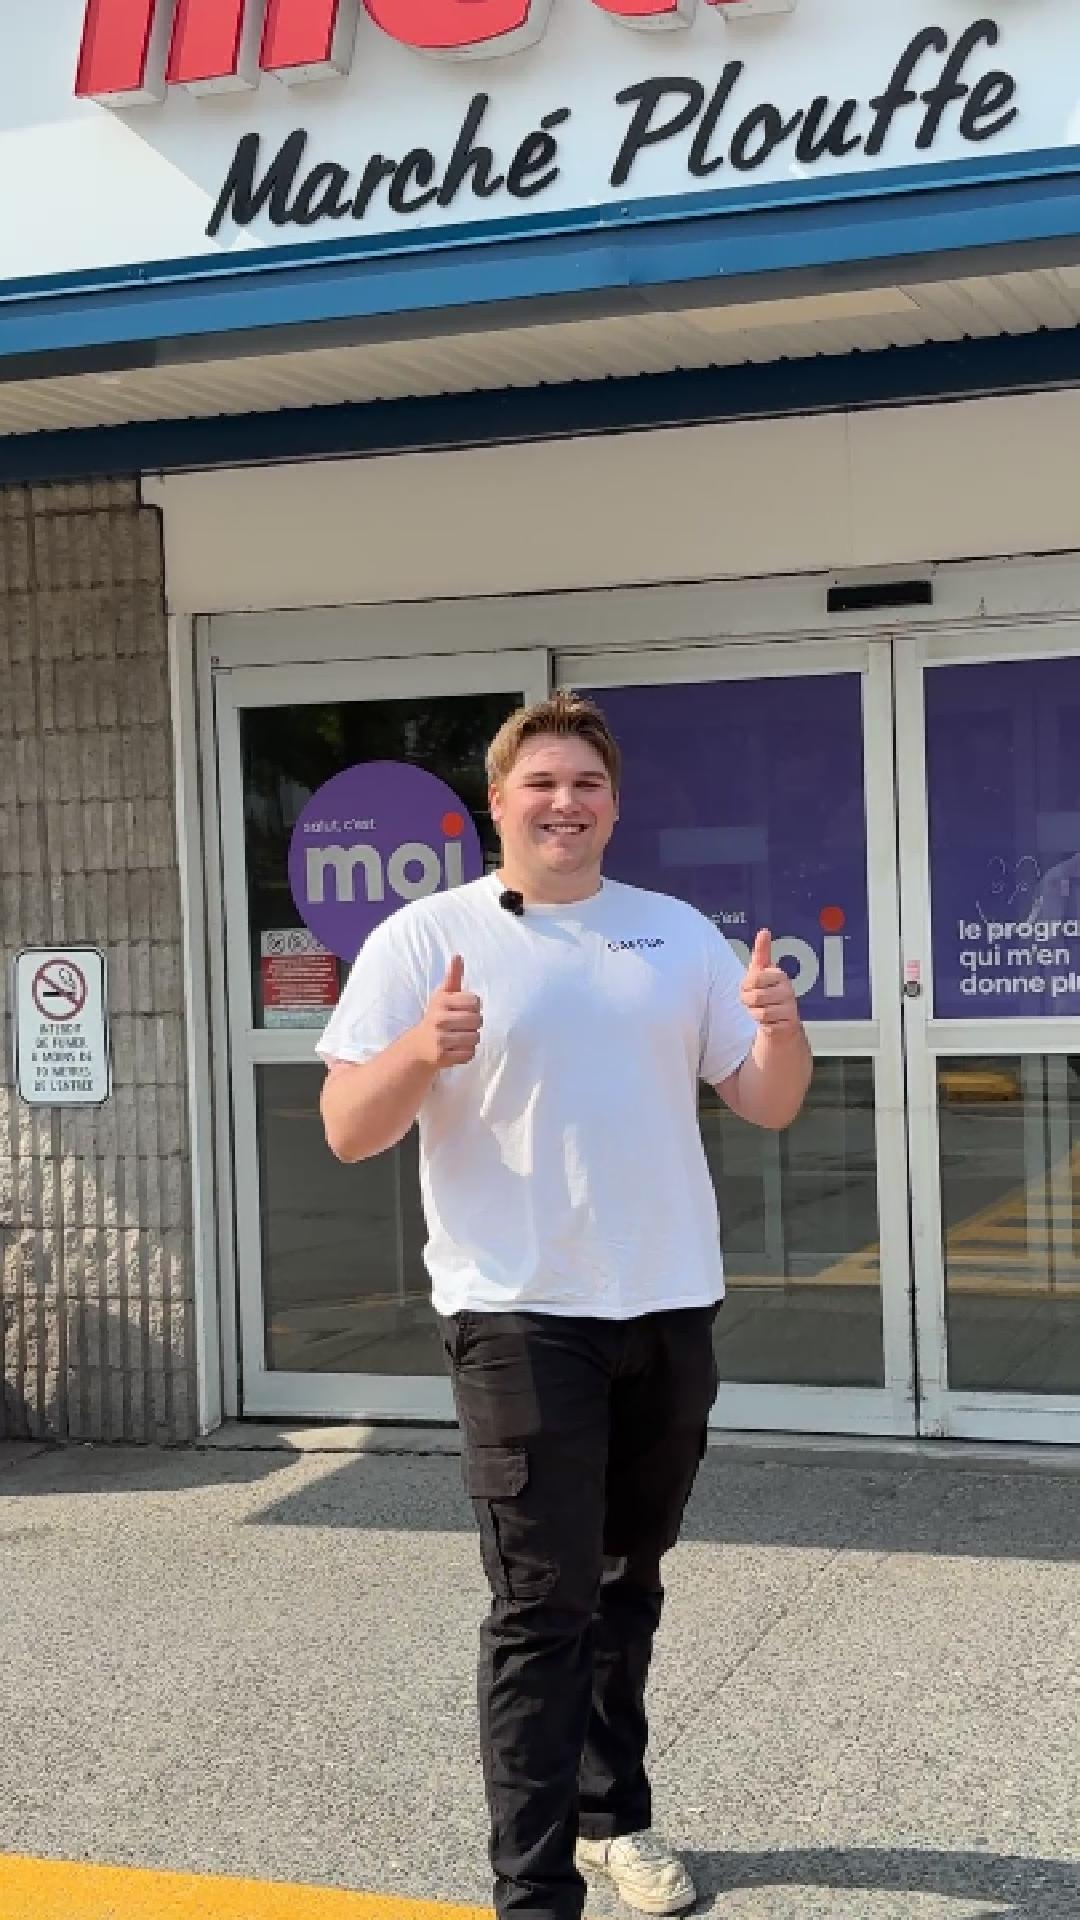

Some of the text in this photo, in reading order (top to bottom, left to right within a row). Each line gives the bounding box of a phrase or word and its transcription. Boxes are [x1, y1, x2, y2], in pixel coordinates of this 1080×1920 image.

[205, 93, 571, 237] Marché
[610, 19, 1019, 186] Plouffe
[306, 811, 464, 903] moi
[727, 906, 846, 999] oi
[959, 919, 982, 940] le
[959, 944, 1070, 972] qui m'en
[959, 972, 1080, 998] donne pl
